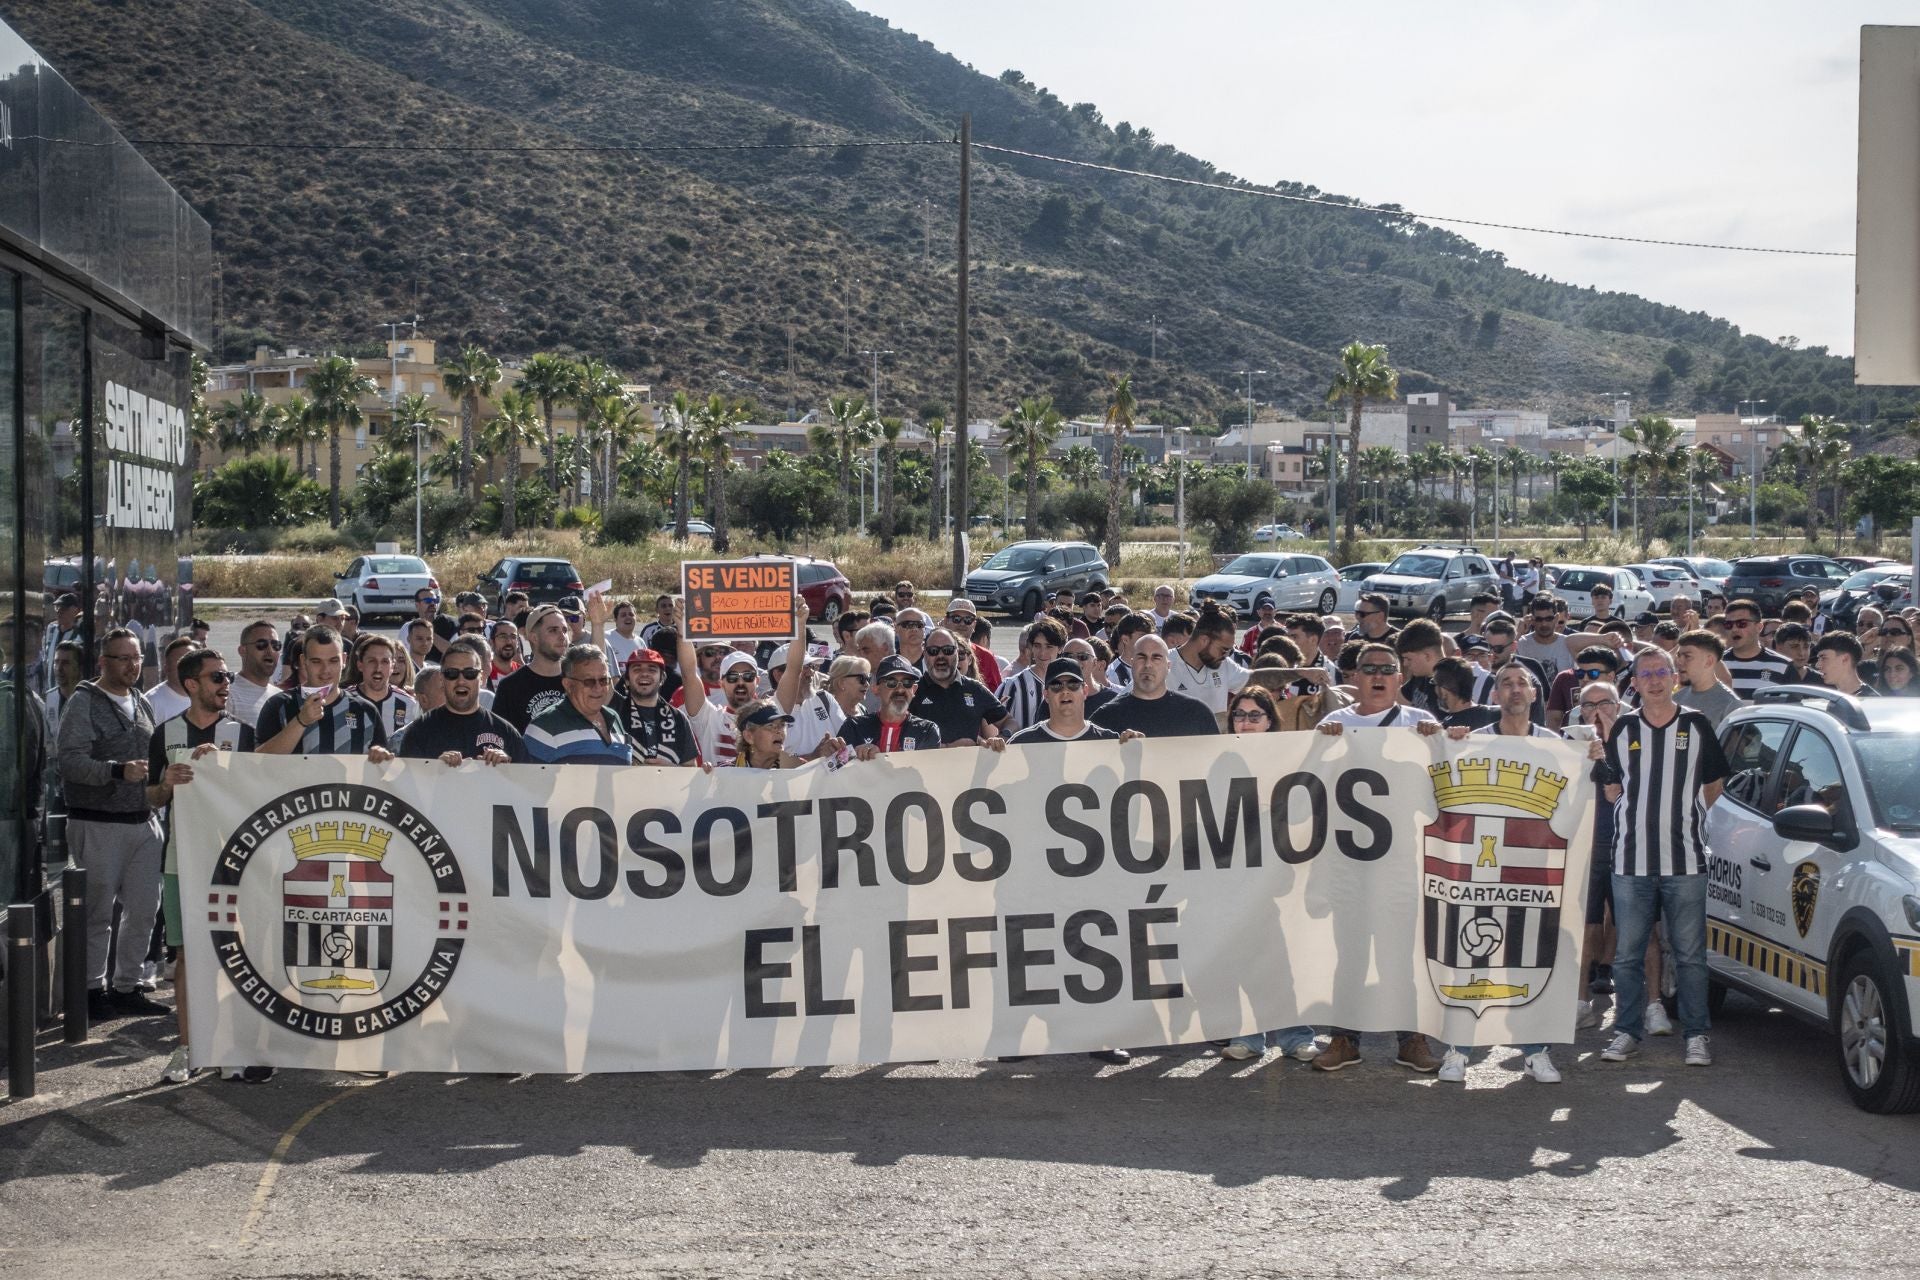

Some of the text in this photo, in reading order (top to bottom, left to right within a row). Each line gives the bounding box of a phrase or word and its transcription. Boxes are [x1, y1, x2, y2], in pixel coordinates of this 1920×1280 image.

[106, 459, 174, 531] ALBINEGRO
[688, 566, 791, 590] SE VENDE
[712, 594, 788, 608] PACO Y FELIPE
[712, 615, 790, 632] SINVERGÜENZAS
[526, 689, 561, 714] CARTHAGO
[224, 790, 453, 879] FEDERACION DE PEÑAS
[492, 767, 1393, 902] NOSOTROS SOMOS
[1708, 855, 1742, 890] HORUS
[1427, 879, 1555, 904] F.C. CARTAGENA
[1707, 883, 1742, 909] SEGURIDAD
[288, 910, 388, 923] F.C. CARTAGENA
[744, 883, 1184, 1019] EL EFESÉ
[220, 941, 455, 1036] FUTBOL CLUB CARTAGENA
